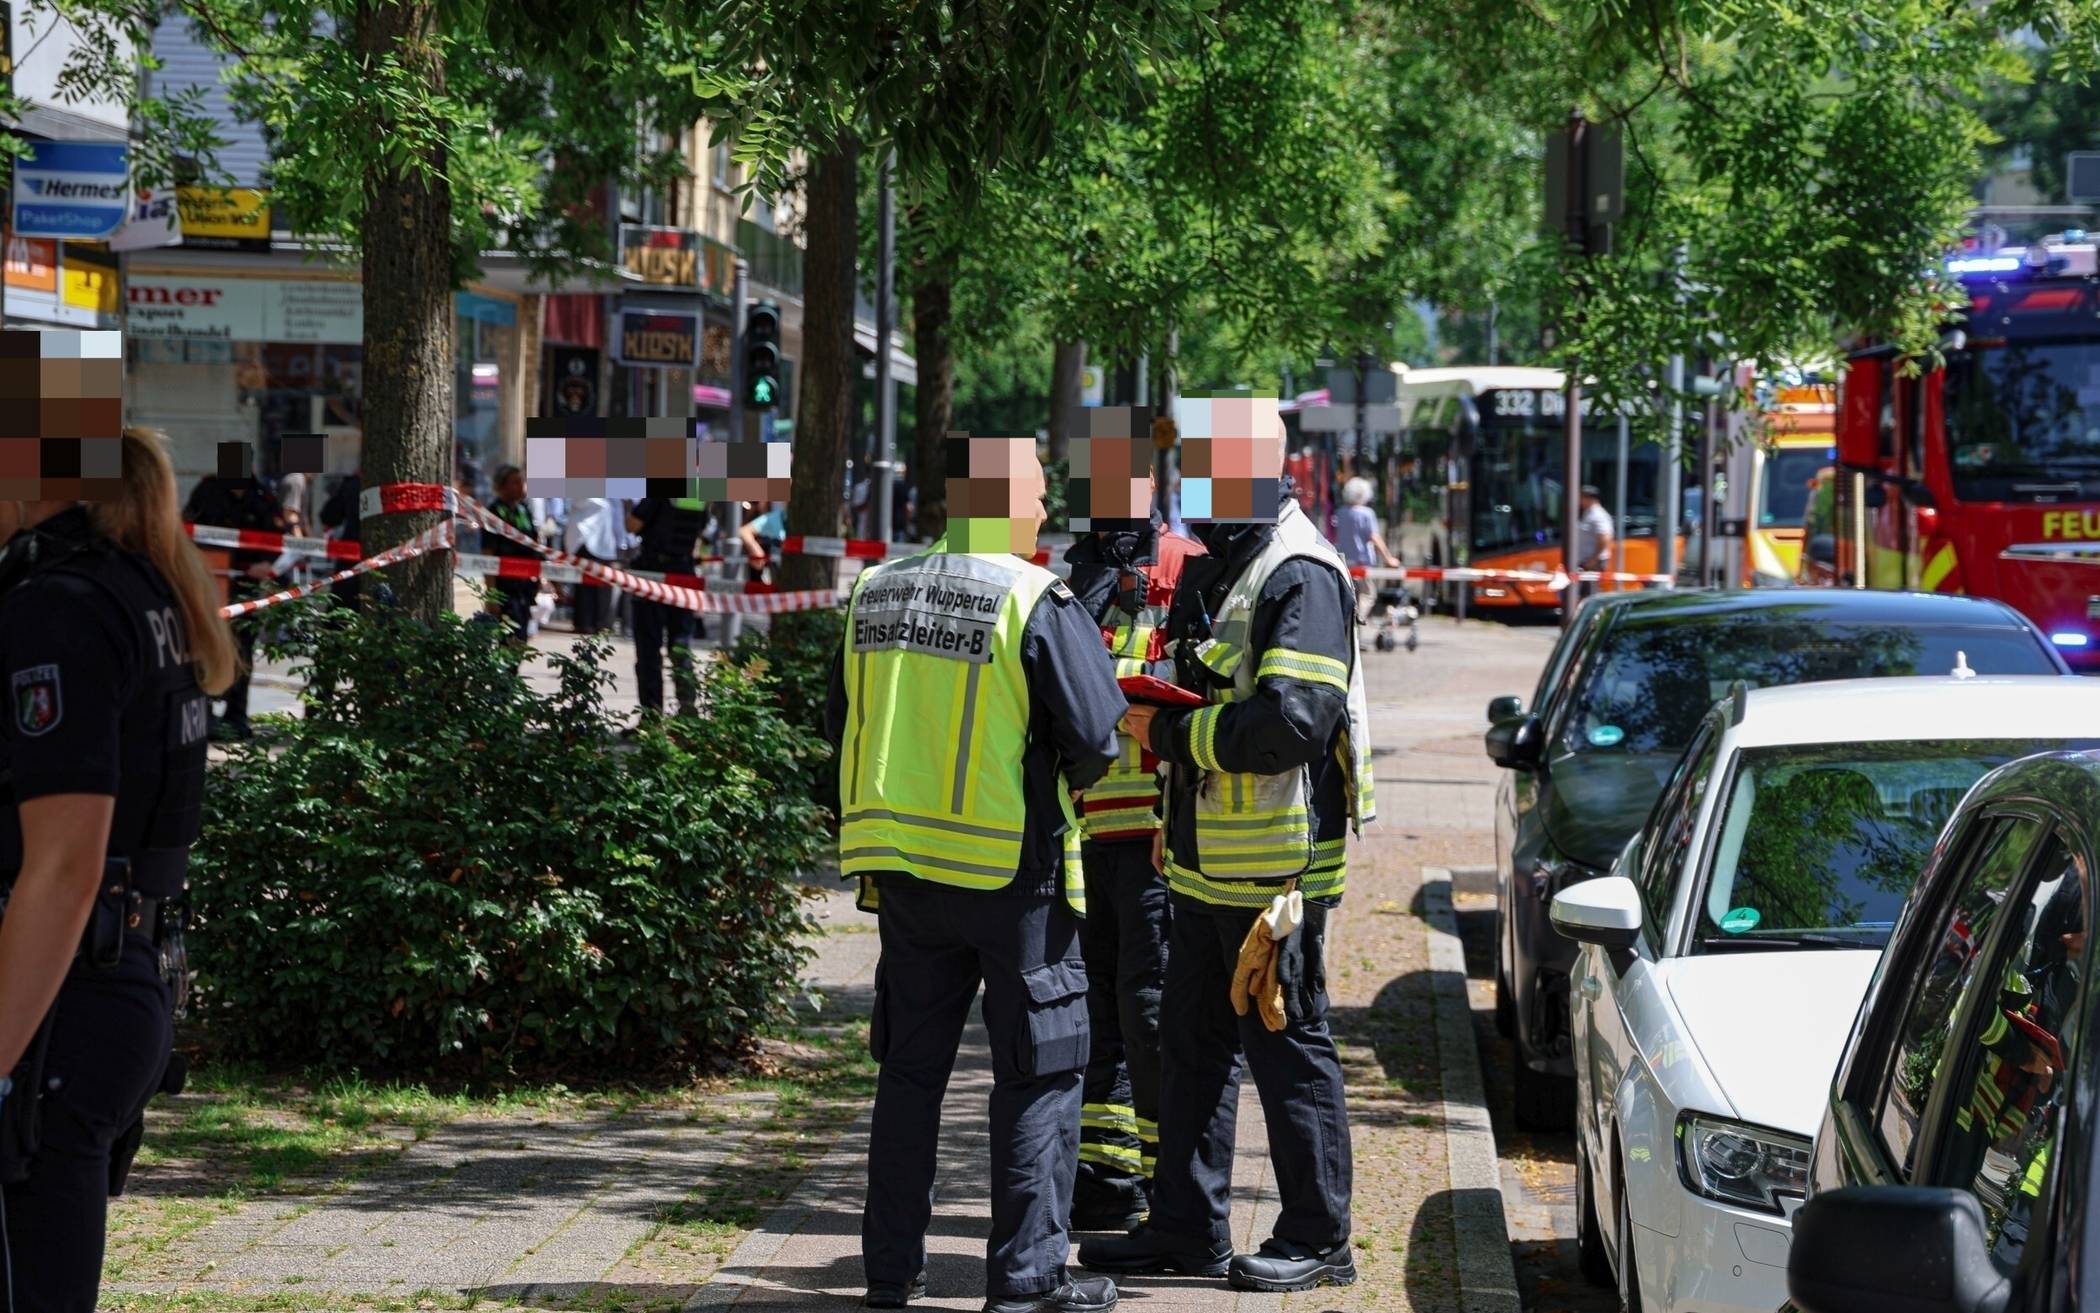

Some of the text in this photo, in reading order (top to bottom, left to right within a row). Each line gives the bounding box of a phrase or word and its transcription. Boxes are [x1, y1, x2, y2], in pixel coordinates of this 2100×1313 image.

[45, 179, 121, 199] Hermes
[21, 210, 103, 229] PaketShop
[624, 245, 697, 286] KIOSK
[128, 286, 224, 307] mer
[623, 331, 693, 361] KIOSK
[1494, 389, 1534, 416] 332
[860, 585, 1000, 614] Feuerwehr Wuppertal
[145, 606, 197, 669] PO
[855, 619, 985, 655] Einsatzleiter-B
